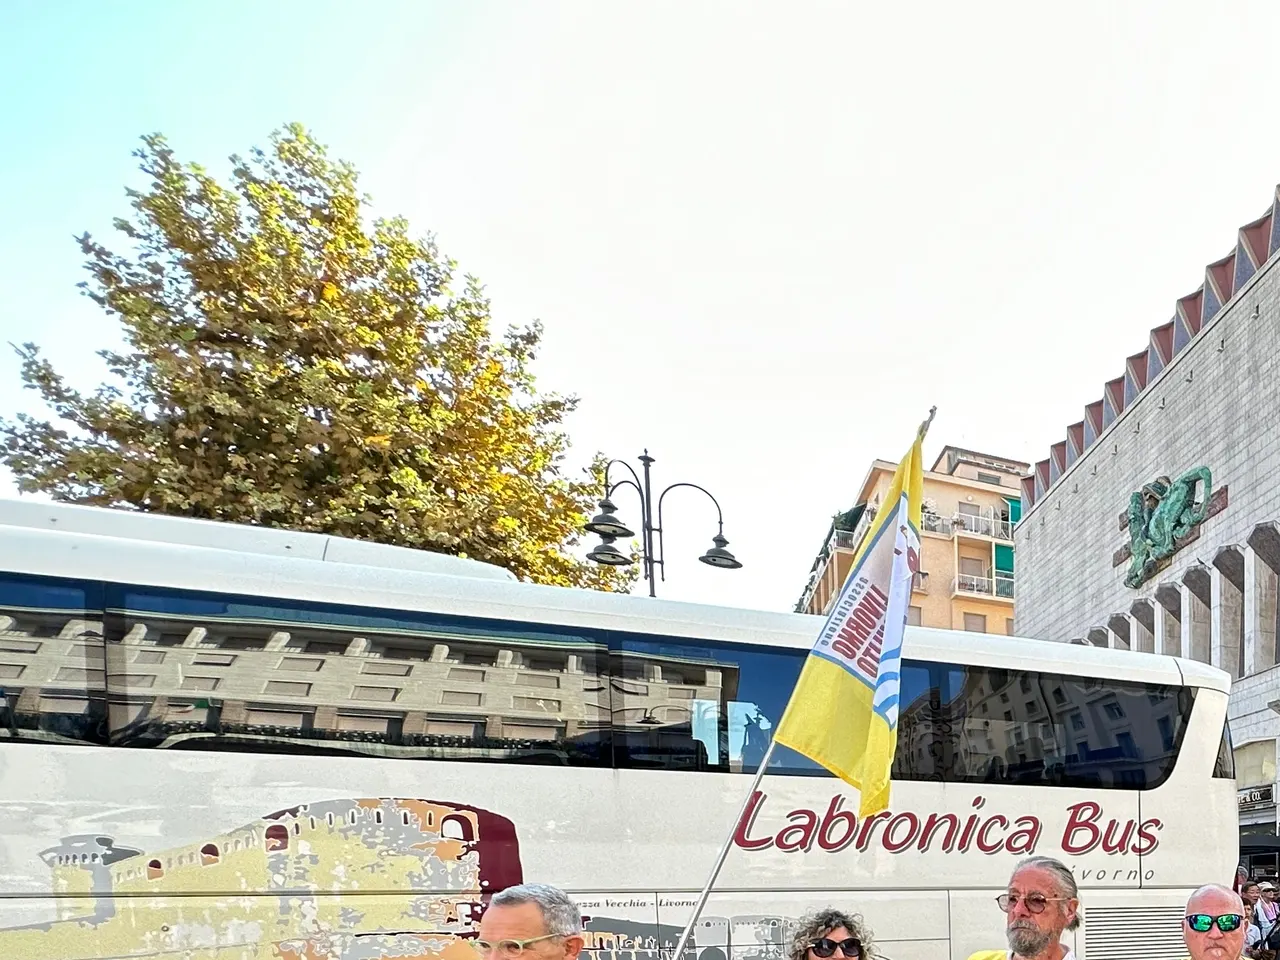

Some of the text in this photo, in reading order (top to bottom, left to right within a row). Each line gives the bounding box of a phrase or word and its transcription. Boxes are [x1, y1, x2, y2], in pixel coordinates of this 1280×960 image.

[734, 790, 1164, 856] Labronica Bus
[1071, 865, 1155, 881] ivorno
[605, 899, 646, 908] Vecchia
